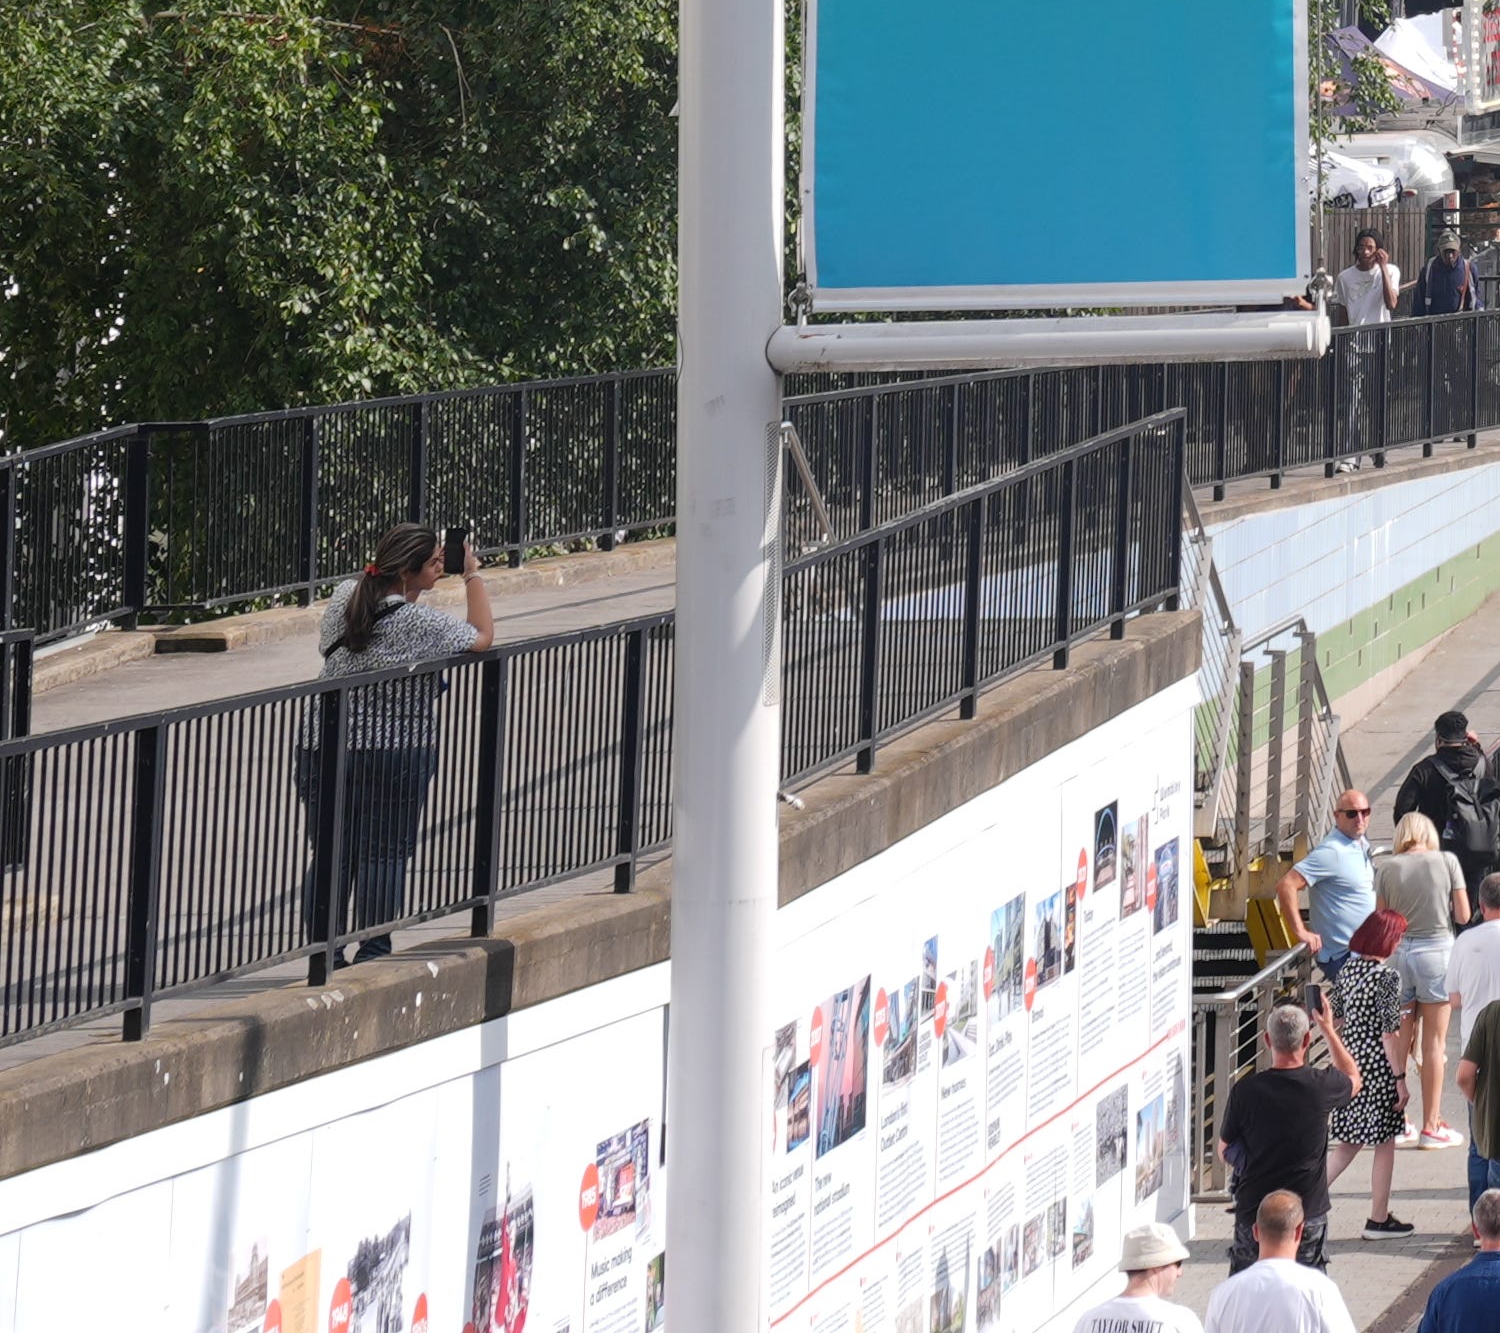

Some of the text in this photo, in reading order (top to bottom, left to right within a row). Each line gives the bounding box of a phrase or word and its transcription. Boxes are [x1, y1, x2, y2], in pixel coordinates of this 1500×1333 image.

[591, 1246, 632, 1280] Music making
[595, 1275, 628, 1304] difference
